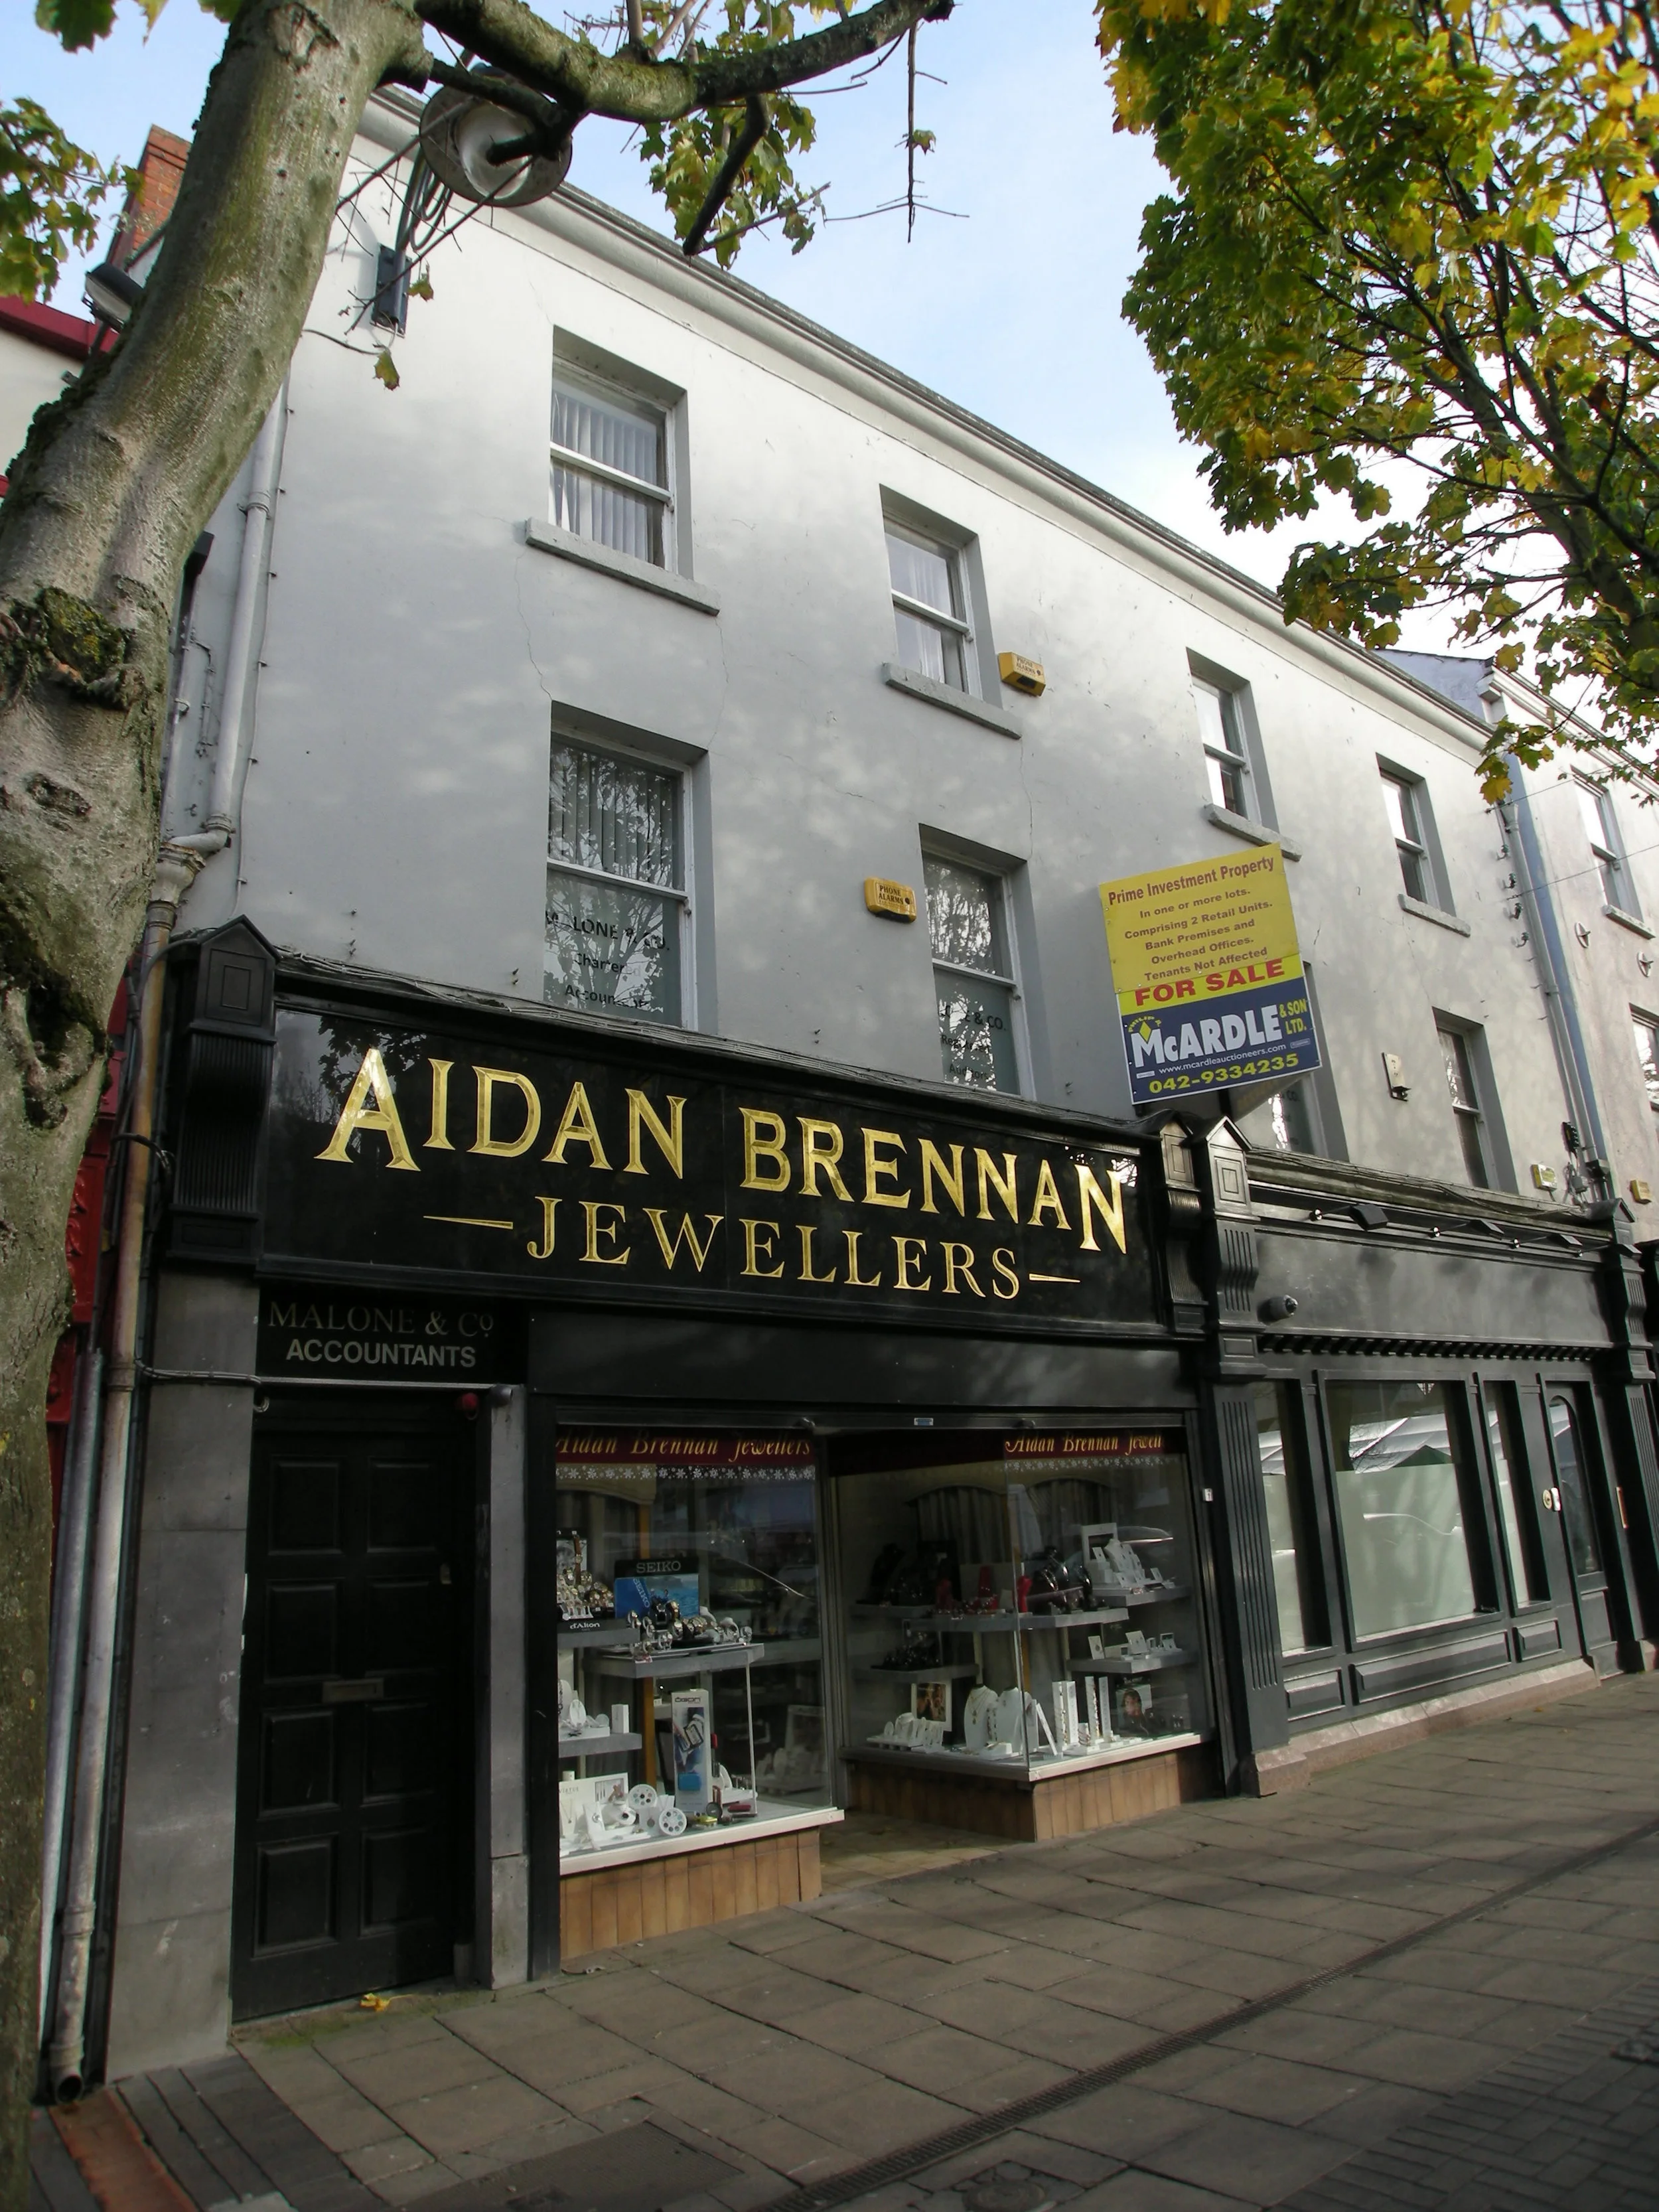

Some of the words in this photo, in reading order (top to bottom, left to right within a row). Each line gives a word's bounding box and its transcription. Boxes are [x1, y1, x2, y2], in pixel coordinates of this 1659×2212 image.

[879, 884, 902, 897] PHONE
[1108, 887, 1144, 906] Prime
[1147, 869, 1218, 897] Investment
[1220, 856, 1275, 880] Property
[879, 892, 904, 905] ALARMS
[1140, 910, 1151, 919] In
[1154, 905, 1175, 916] one
[1178, 901, 1190, 910] or
[1193, 895, 1222, 907] more
[1225, 888, 1251, 900] lots.
[1125, 920, 1188, 940] Comprising
[1191, 917, 1198, 925] 2
[1201, 909, 1236, 923] Retail
[1238, 901, 1273, 915] Units.
[1145, 939, 1175, 951] Bank
[1177, 926, 1231, 944] Premises
[1234, 919, 1256, 931] and
[1145, 964, 1191, 982] Tenants
[1194, 958, 1215, 971] Not
[1218, 946, 1267, 966] Affected
[1151, 945, 1206, 965] Overhead
[1209, 936, 1254, 952] Offices.
[1135, 980, 1196, 1006] FOR
[1205, 958, 1285, 992] SALE
[1131, 1004, 1283, 1069] McARDLE
[1279, 1005, 1287, 1018] &
[1287, 999, 1307, 1017] SON
[1285, 1018, 1307, 1035] LTD.
[1149, 1053, 1299, 1094] 042-9334235
[1159, 1044, 1286, 1074] www.mcardleauctioneers.com
[314, 1047, 687, 1180] AIDAN
[739, 1107, 1127, 1254] BRENNAN
[527, 1196, 1019, 1300] JEWELLERS
[268, 1301, 416, 1334] MALONE
[425, 1310, 449, 1336] &
[286, 1339, 476, 1368] ACCOUNTANTS
[555, 1428, 617, 1454] Aidan
[630, 1429, 719, 1455] Brennan
[1005, 1431, 1055, 1453] Aidan
[1062, 1429, 1119, 1453] Brennan
[636, 1560, 682, 1574] SEIKO
[632, 1579, 650, 1608] SEIKO
